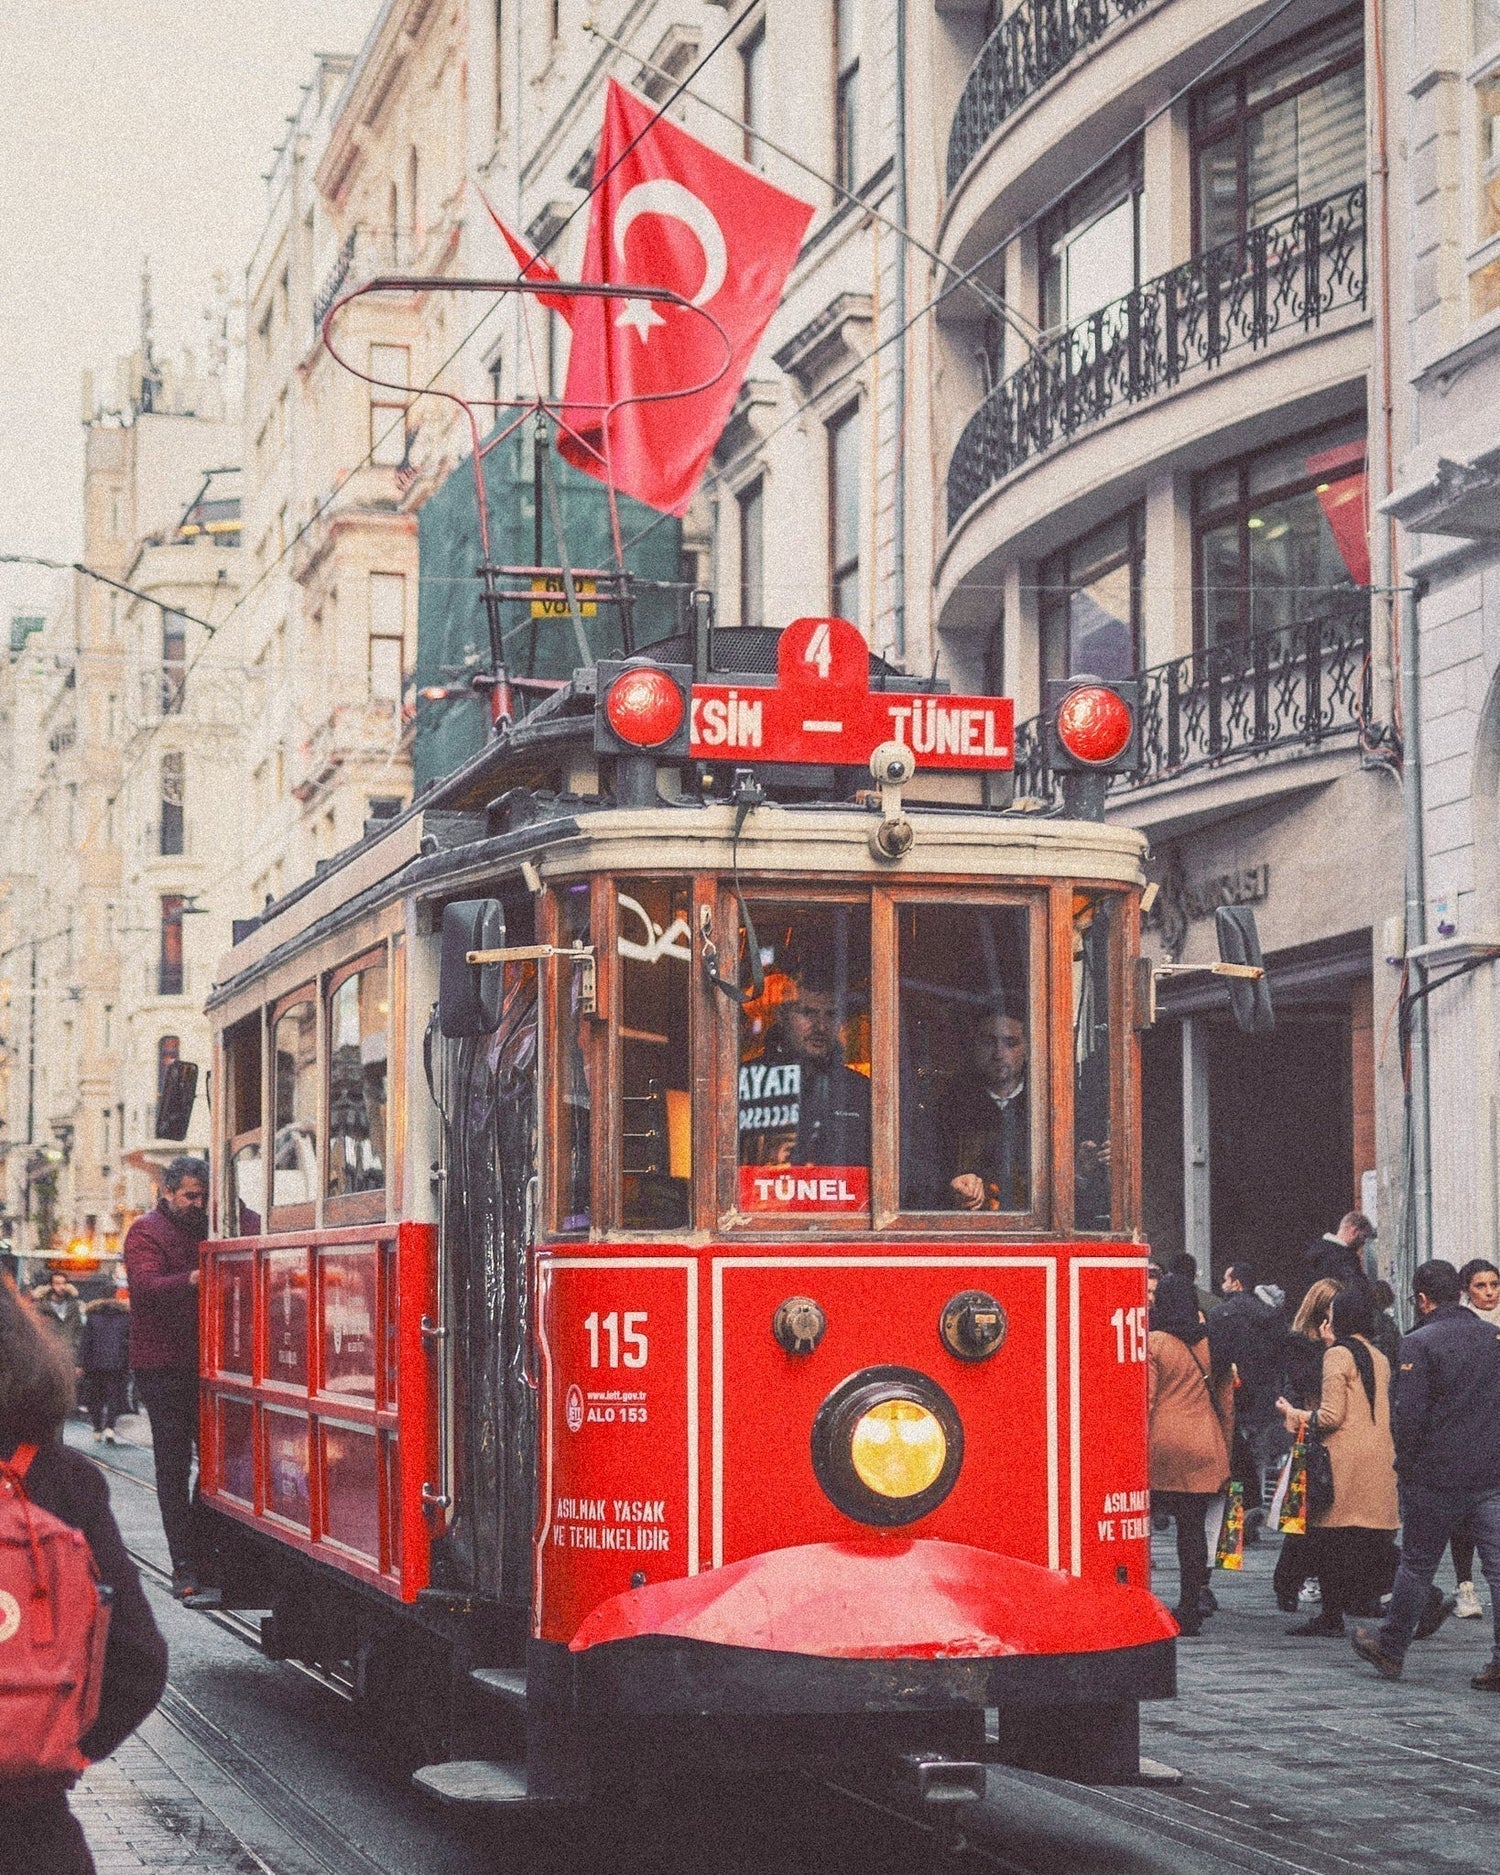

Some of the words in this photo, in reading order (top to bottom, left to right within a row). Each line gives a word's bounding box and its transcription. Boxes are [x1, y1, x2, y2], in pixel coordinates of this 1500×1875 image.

[804, 623, 832, 679] 4
[888, 699, 1008, 756] TÜNEL
[754, 1175, 856, 1201] TÜNEL
[584, 1311, 648, 1368] 115
[1111, 1307, 1146, 1363] 115
[587, 1408, 616, 1422] ALO
[619, 1408, 648, 1423] 153
[613, 1500, 665, 1523] YASAK
[553, 1525, 565, 1546] VE
[1097, 1519, 1116, 1542] VE
